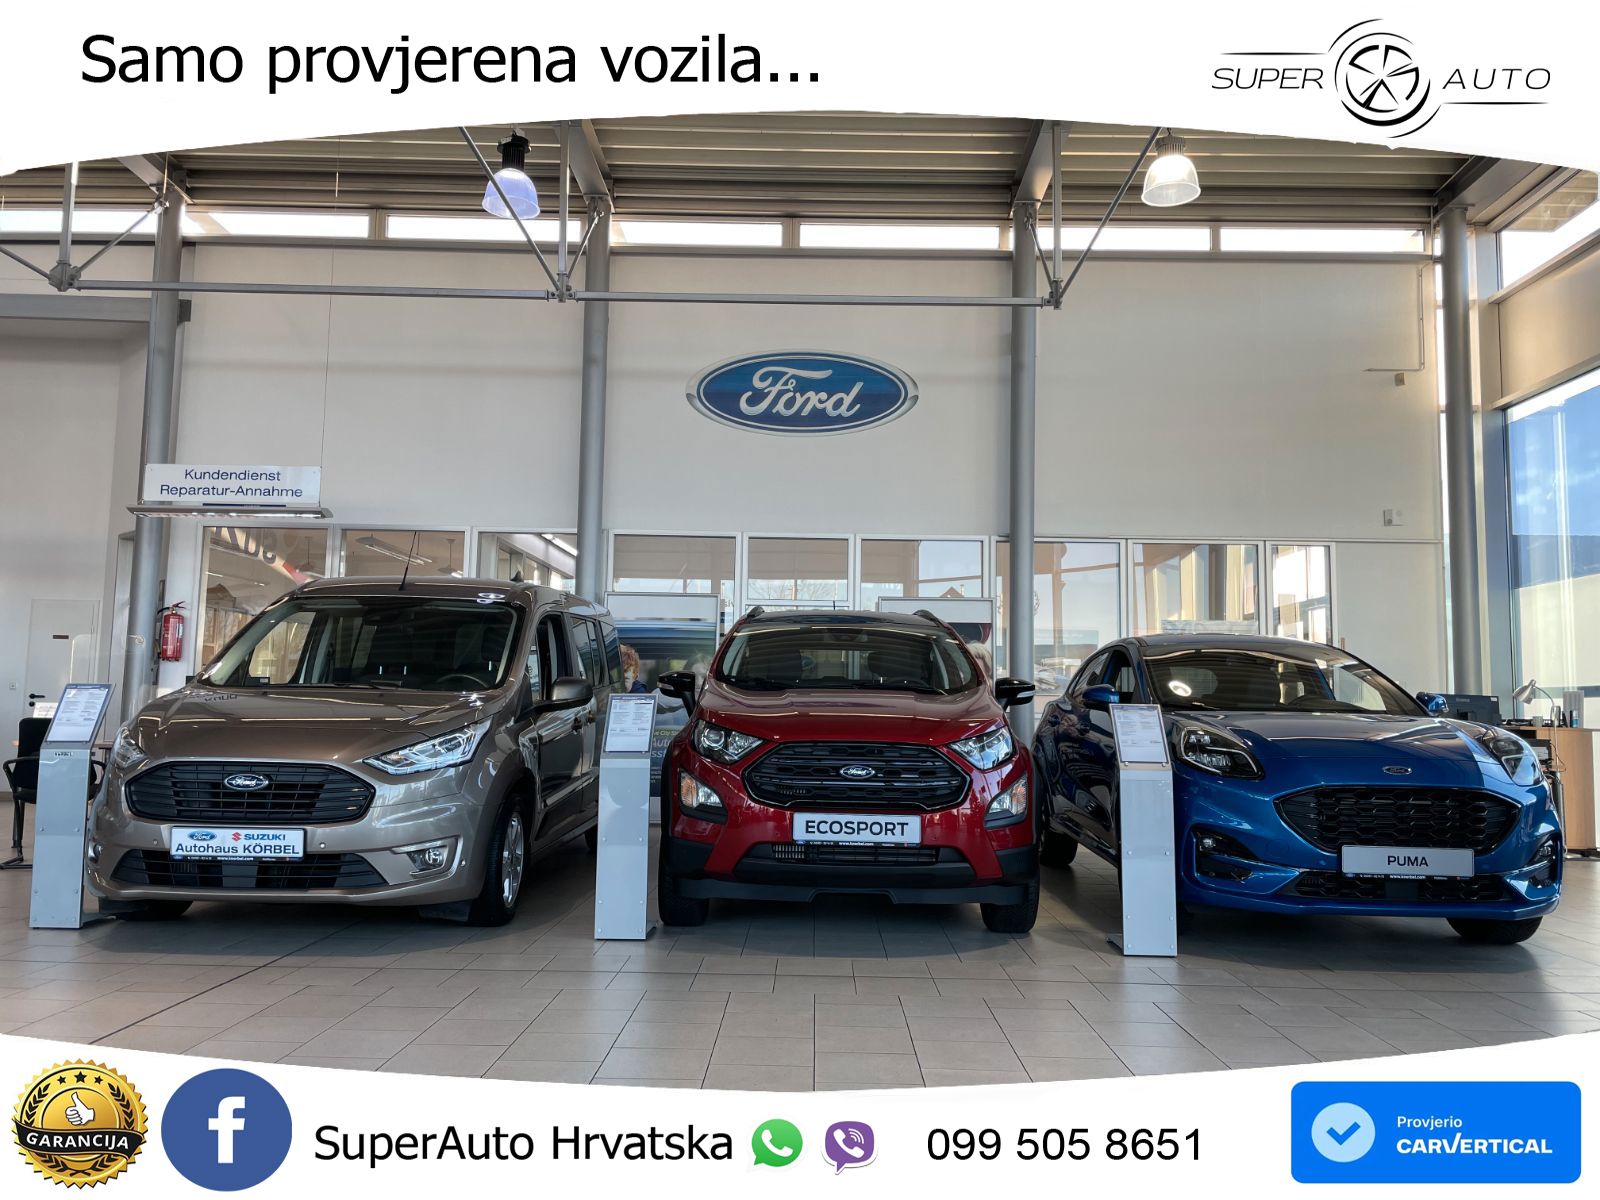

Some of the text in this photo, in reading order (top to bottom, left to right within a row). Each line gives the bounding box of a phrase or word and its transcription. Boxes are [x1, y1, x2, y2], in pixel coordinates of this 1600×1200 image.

[738, 365, 865, 418] Ford
[184, 468, 281, 482] Kundendienst
[160, 484, 303, 498] Reparatur-Annahme
[804, 819, 909, 837] ECOSPORT
[243, 833, 286, 841] SUZUKI
[175, 842, 300, 855] Autohaus KÖRBEL
[1387, 855, 1429, 867] PUMA
